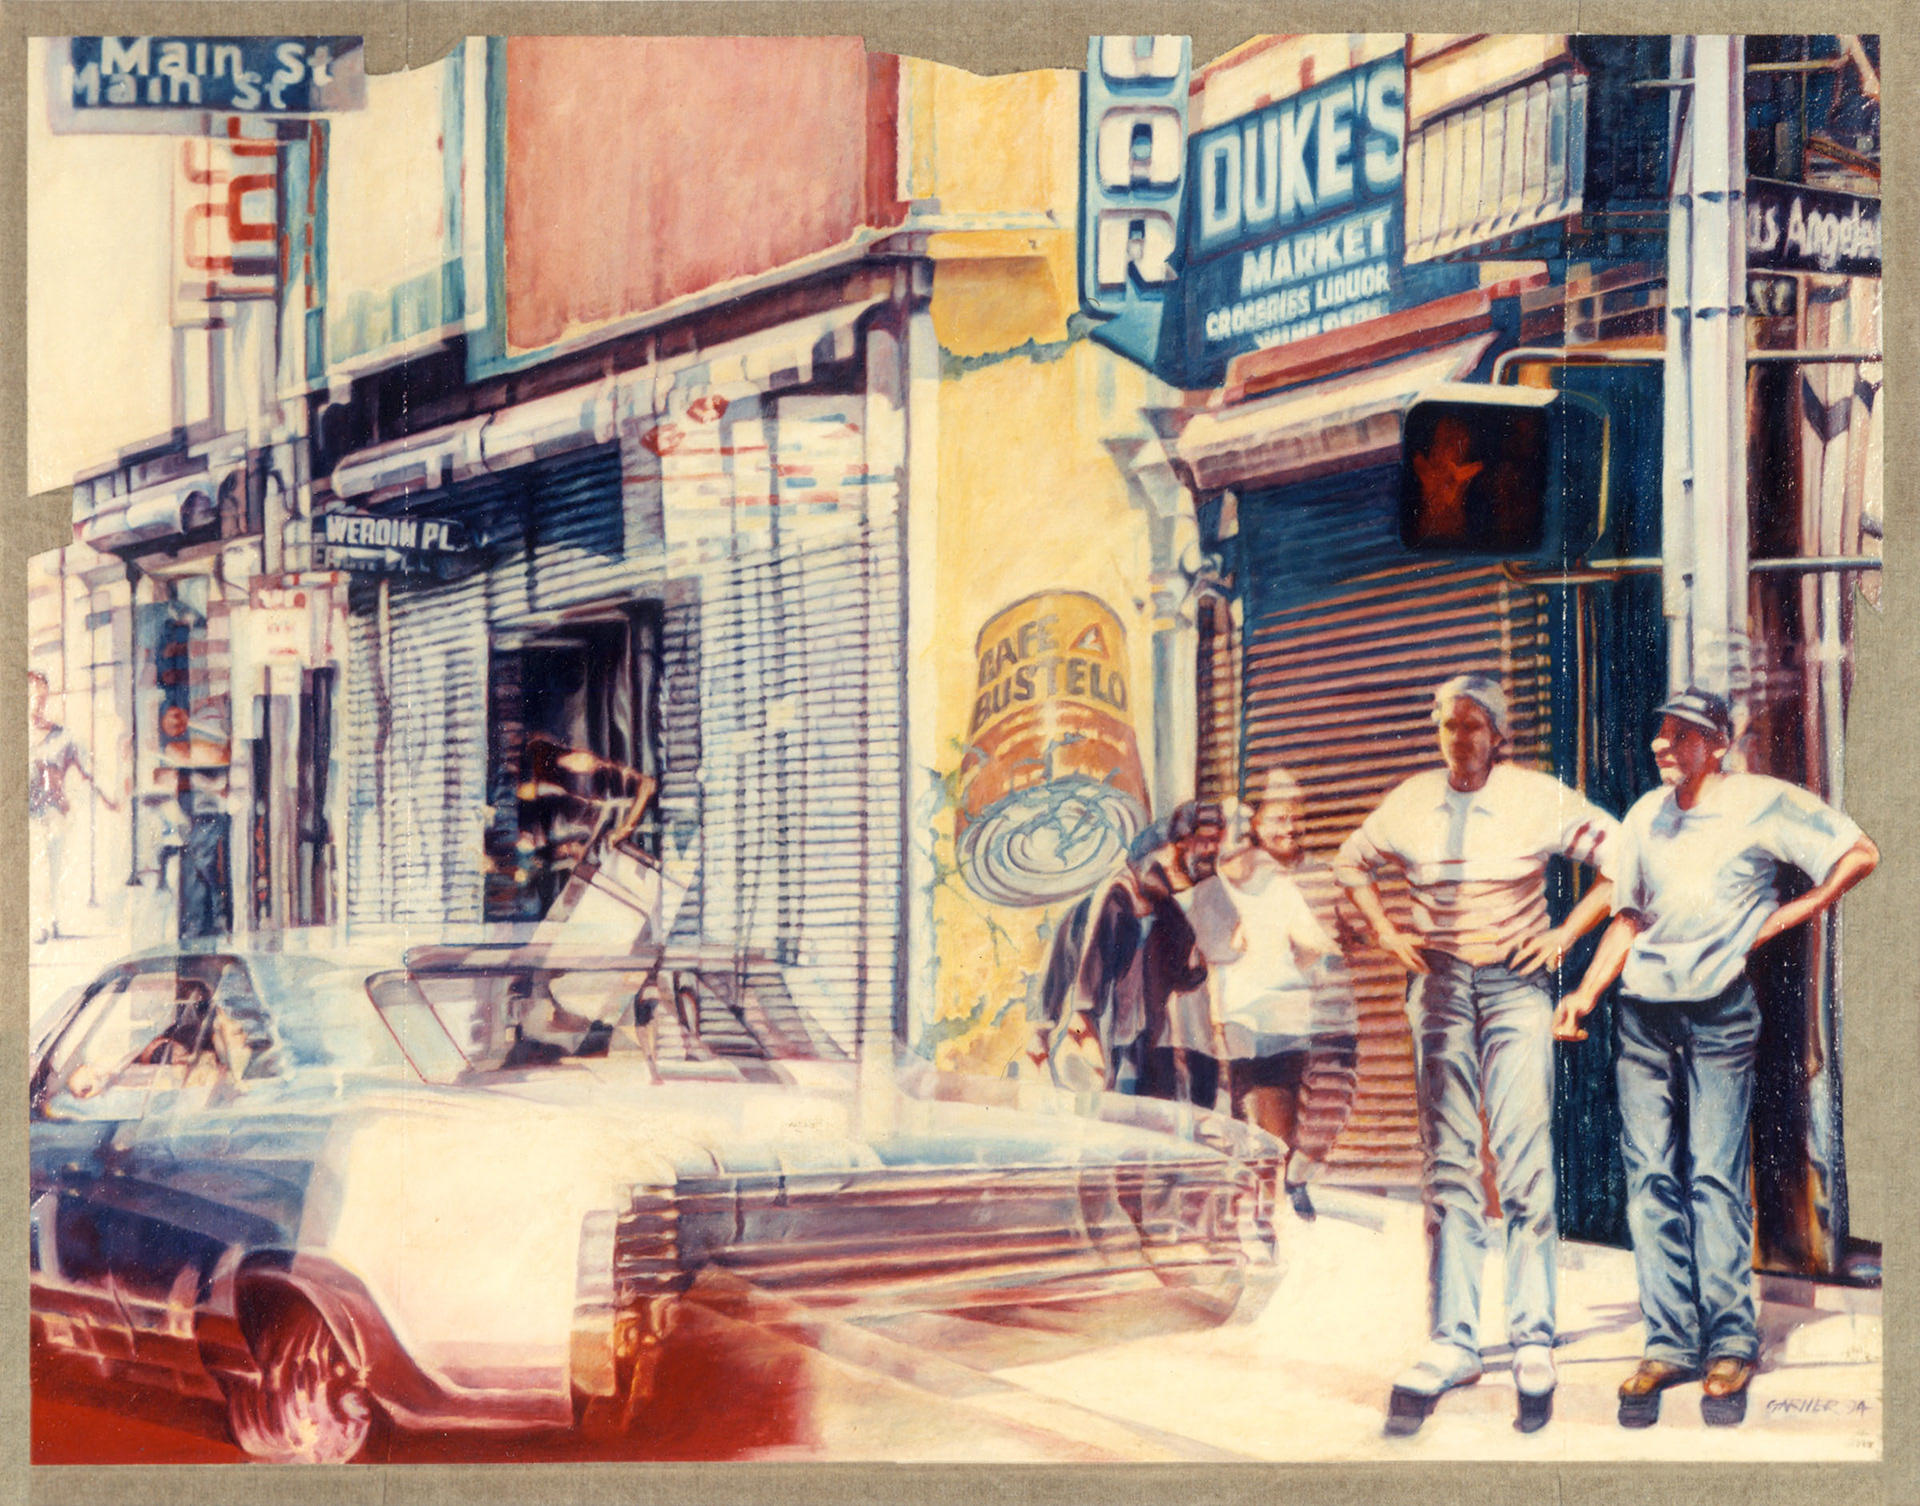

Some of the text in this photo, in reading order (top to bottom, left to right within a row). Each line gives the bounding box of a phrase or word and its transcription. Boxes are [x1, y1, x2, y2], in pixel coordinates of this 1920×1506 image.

[62, 62, 201, 105] Main
[101, 36, 334, 86] Main St
[1201, 66, 1405, 239] DUKE'S
[1240, 207, 1392, 297] MARKET
